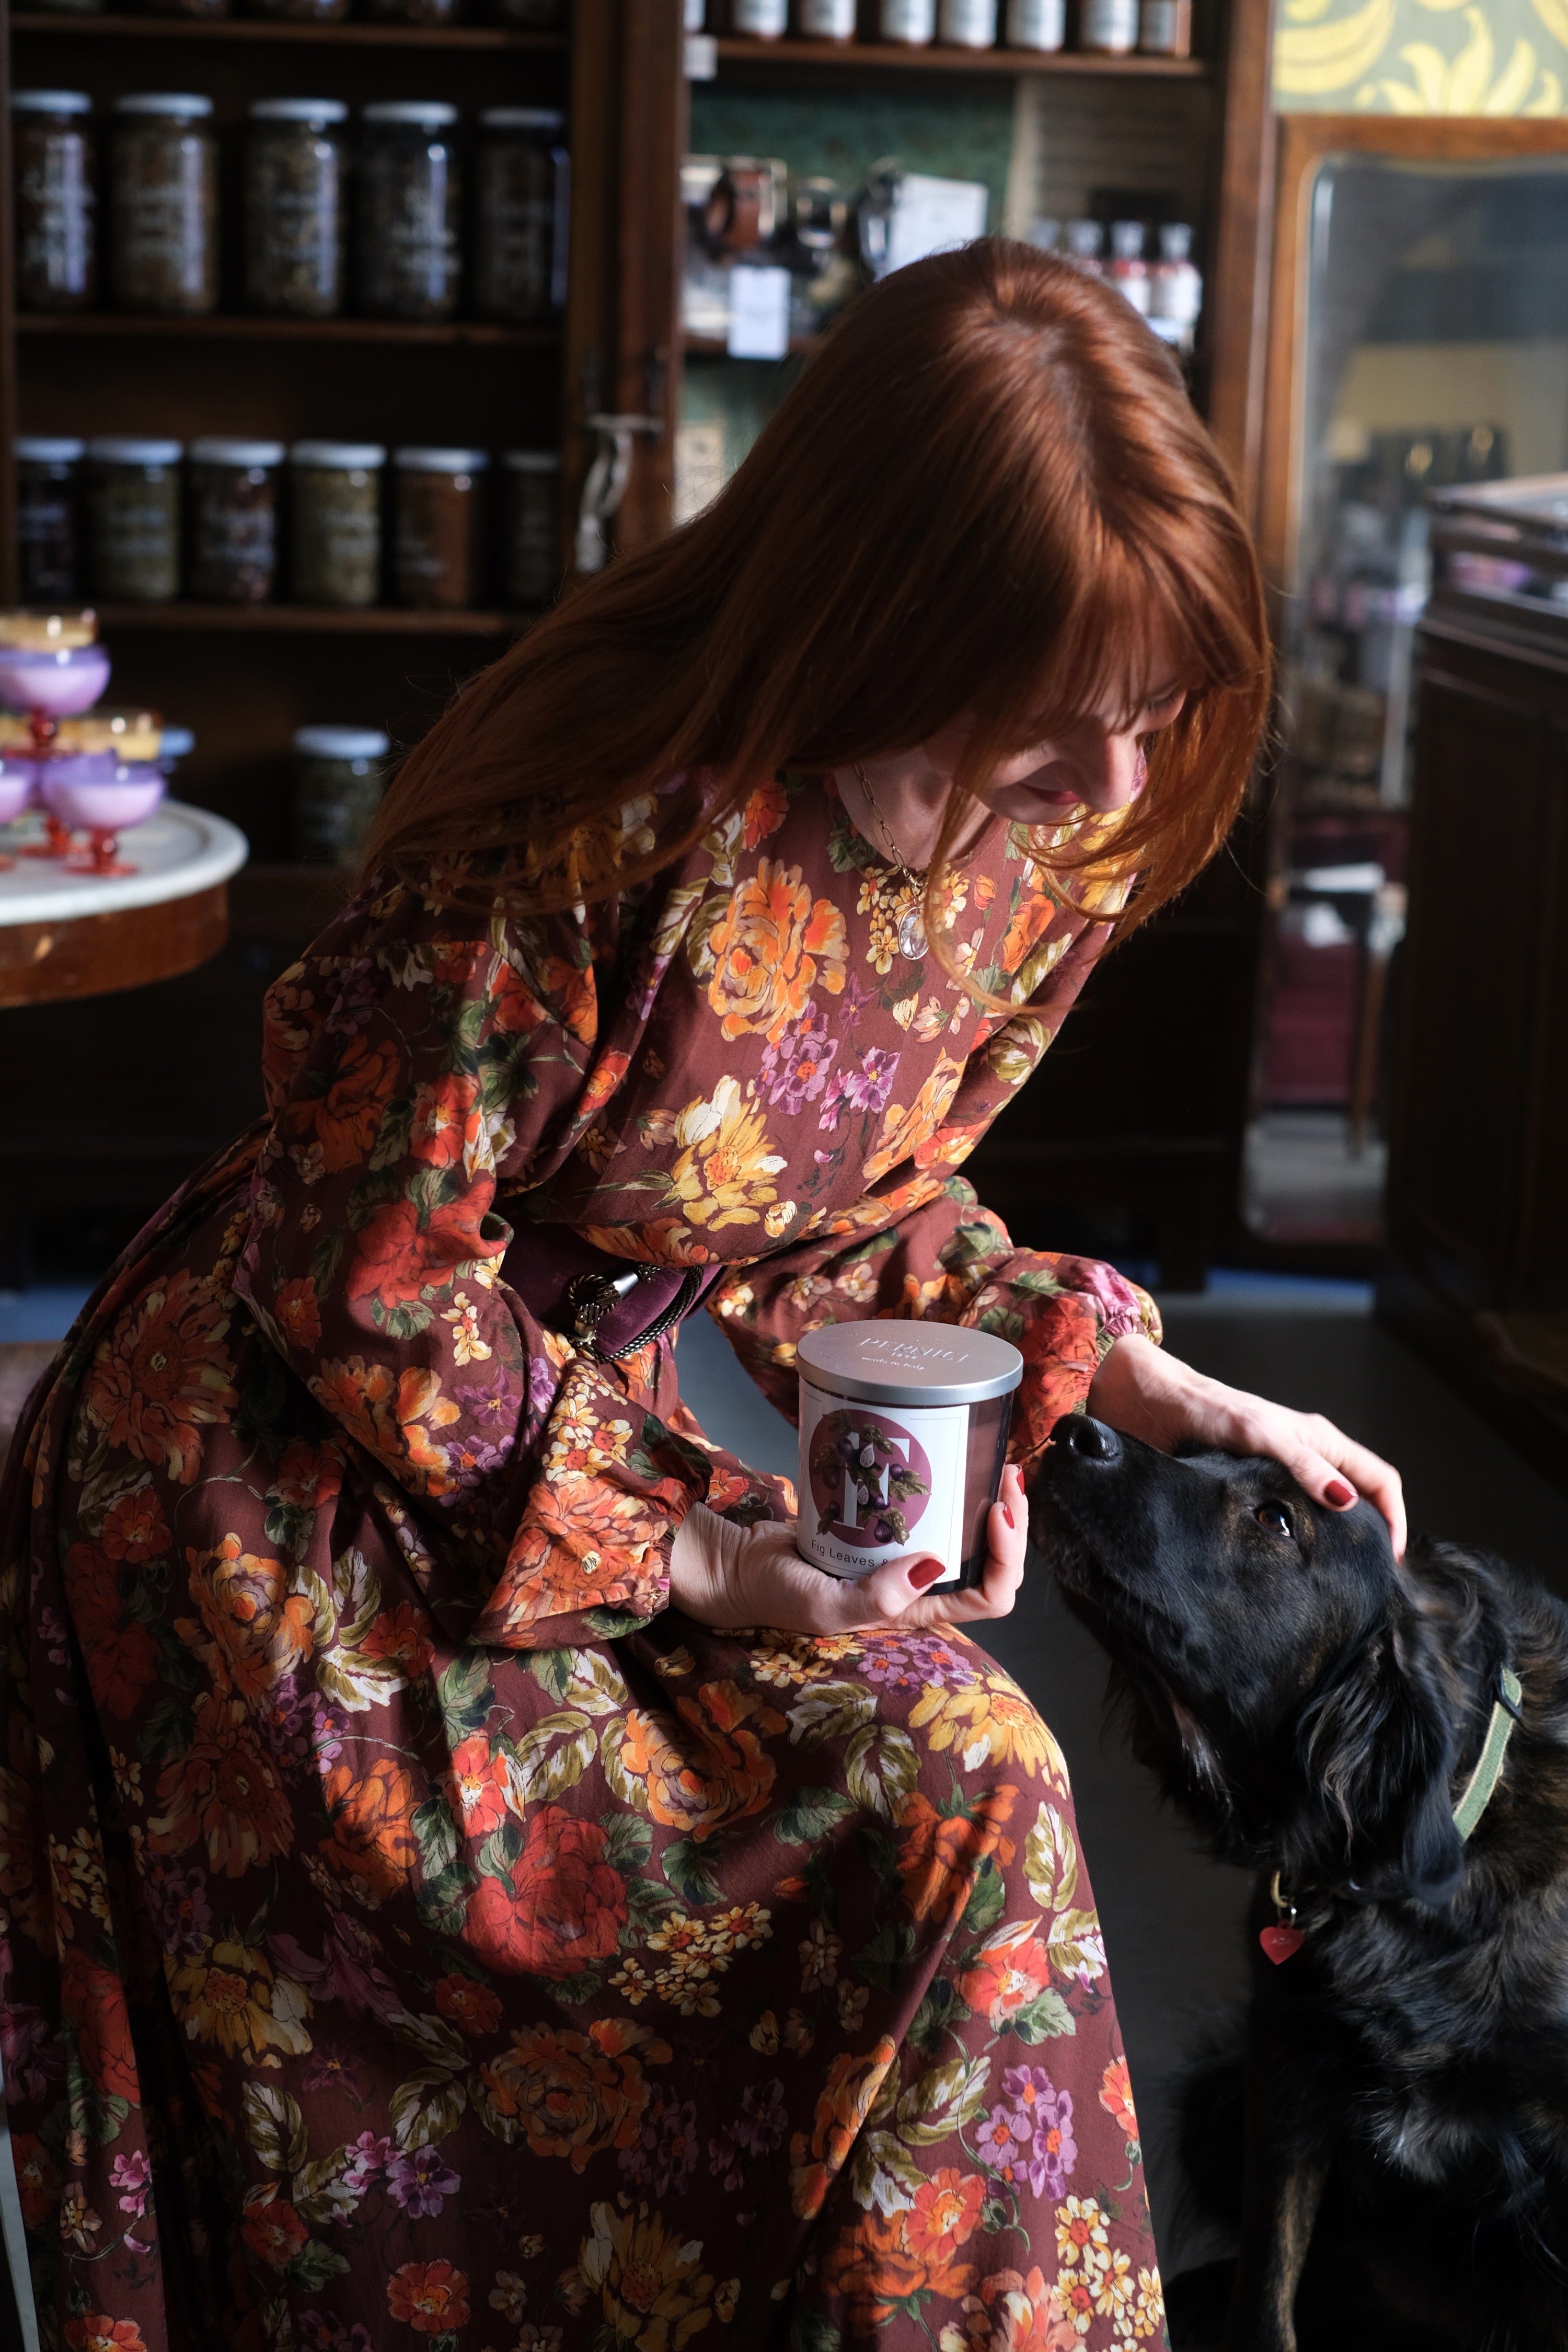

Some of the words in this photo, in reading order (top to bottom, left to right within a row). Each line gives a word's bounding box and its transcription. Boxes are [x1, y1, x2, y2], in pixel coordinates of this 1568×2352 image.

[903, 1362, 925, 1370] Italy
[811, 1539, 825, 1556] Fig
[829, 1547, 875, 1567] Leaves
